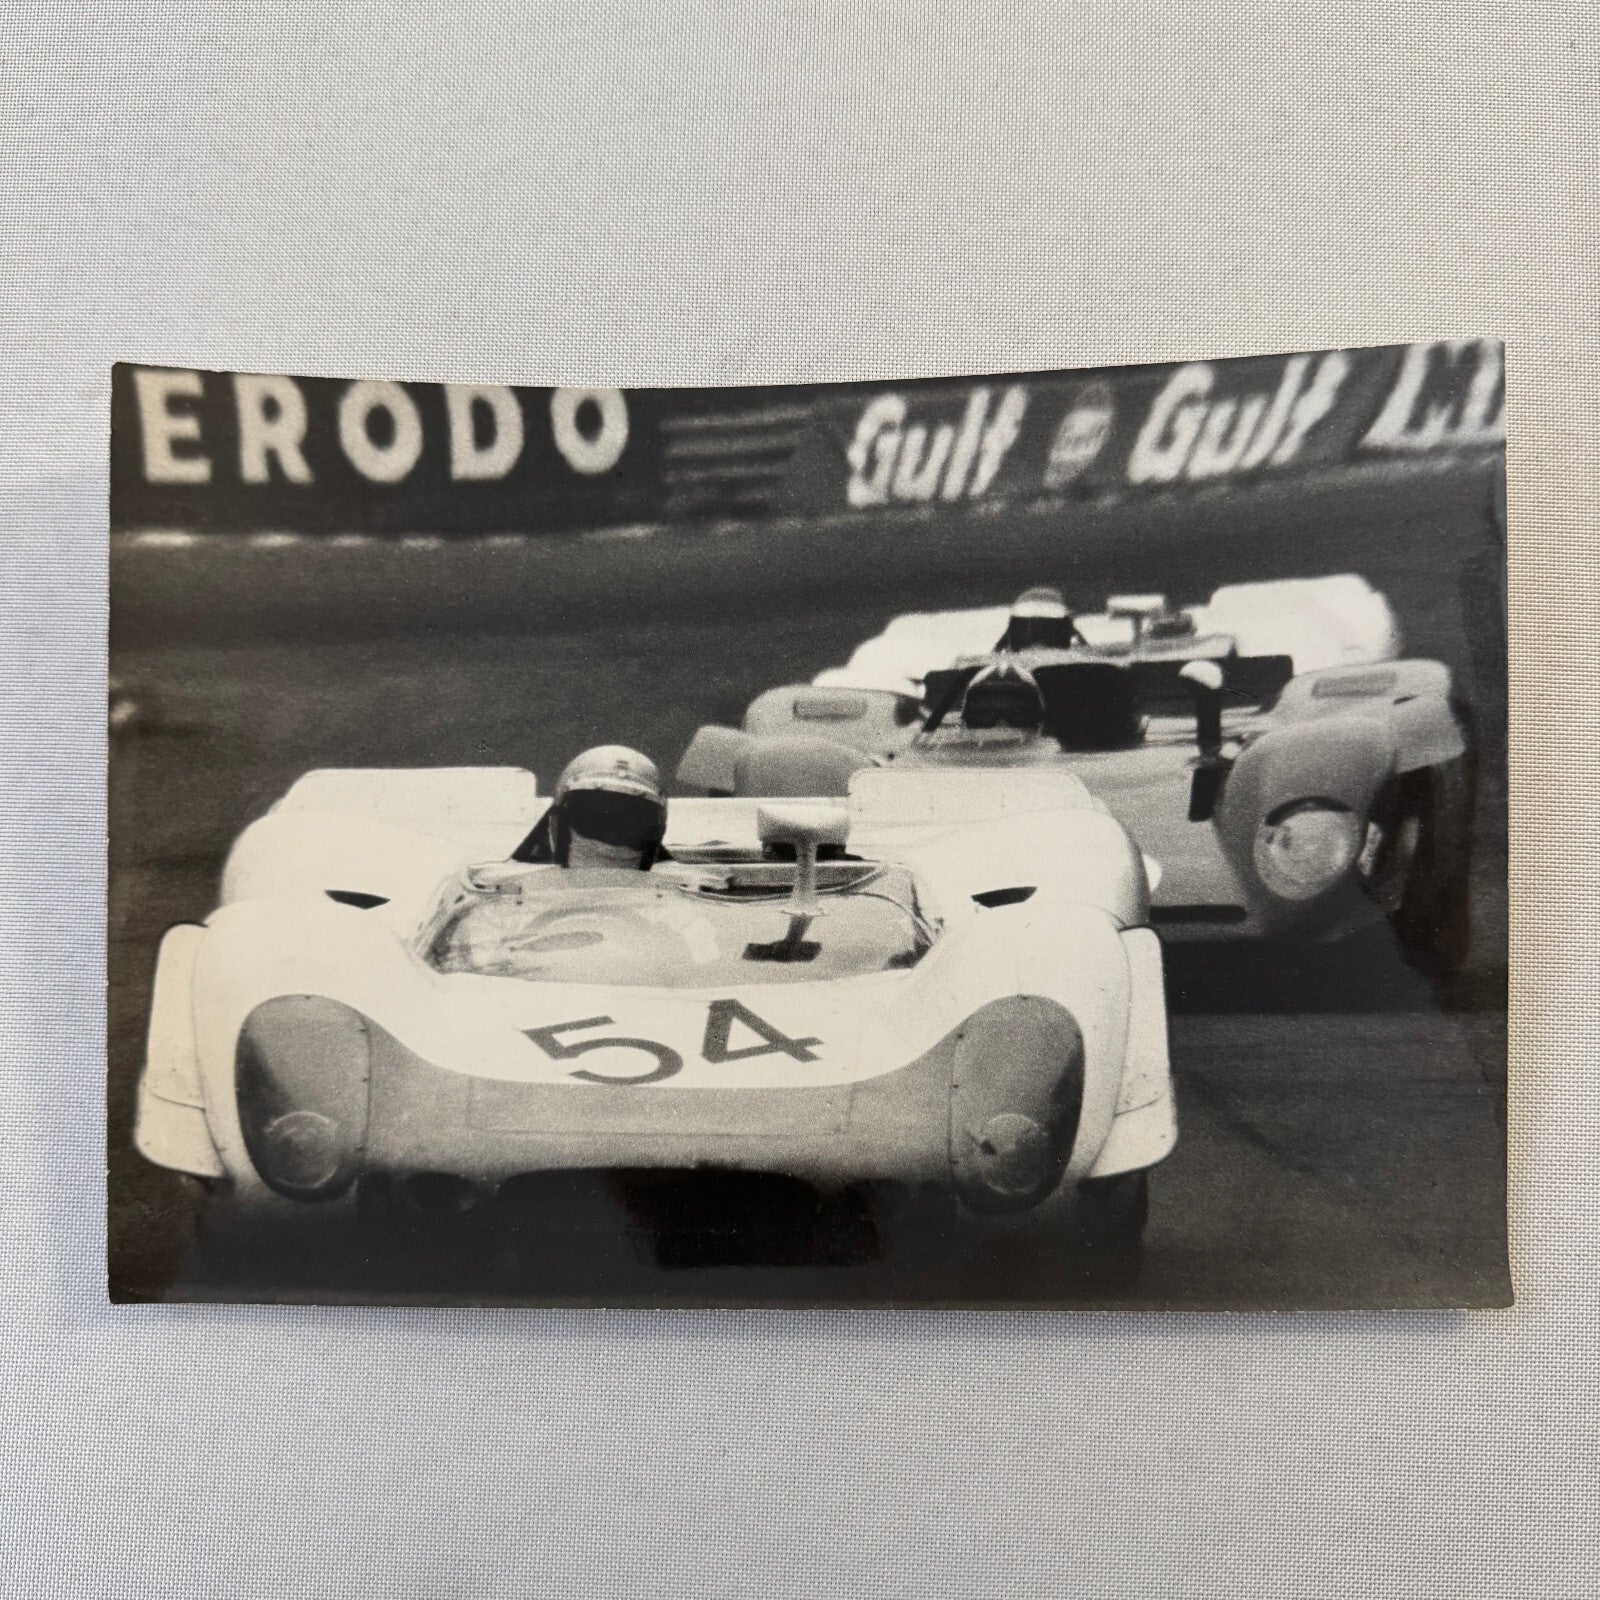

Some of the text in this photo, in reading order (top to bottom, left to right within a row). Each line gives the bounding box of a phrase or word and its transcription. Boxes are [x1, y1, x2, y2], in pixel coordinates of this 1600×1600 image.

[134, 369, 630, 484] ERODO
[847, 384, 1026, 507] Gulf
[1127, 352, 1350, 484] Gulf
[521, 998, 825, 1086] 54
